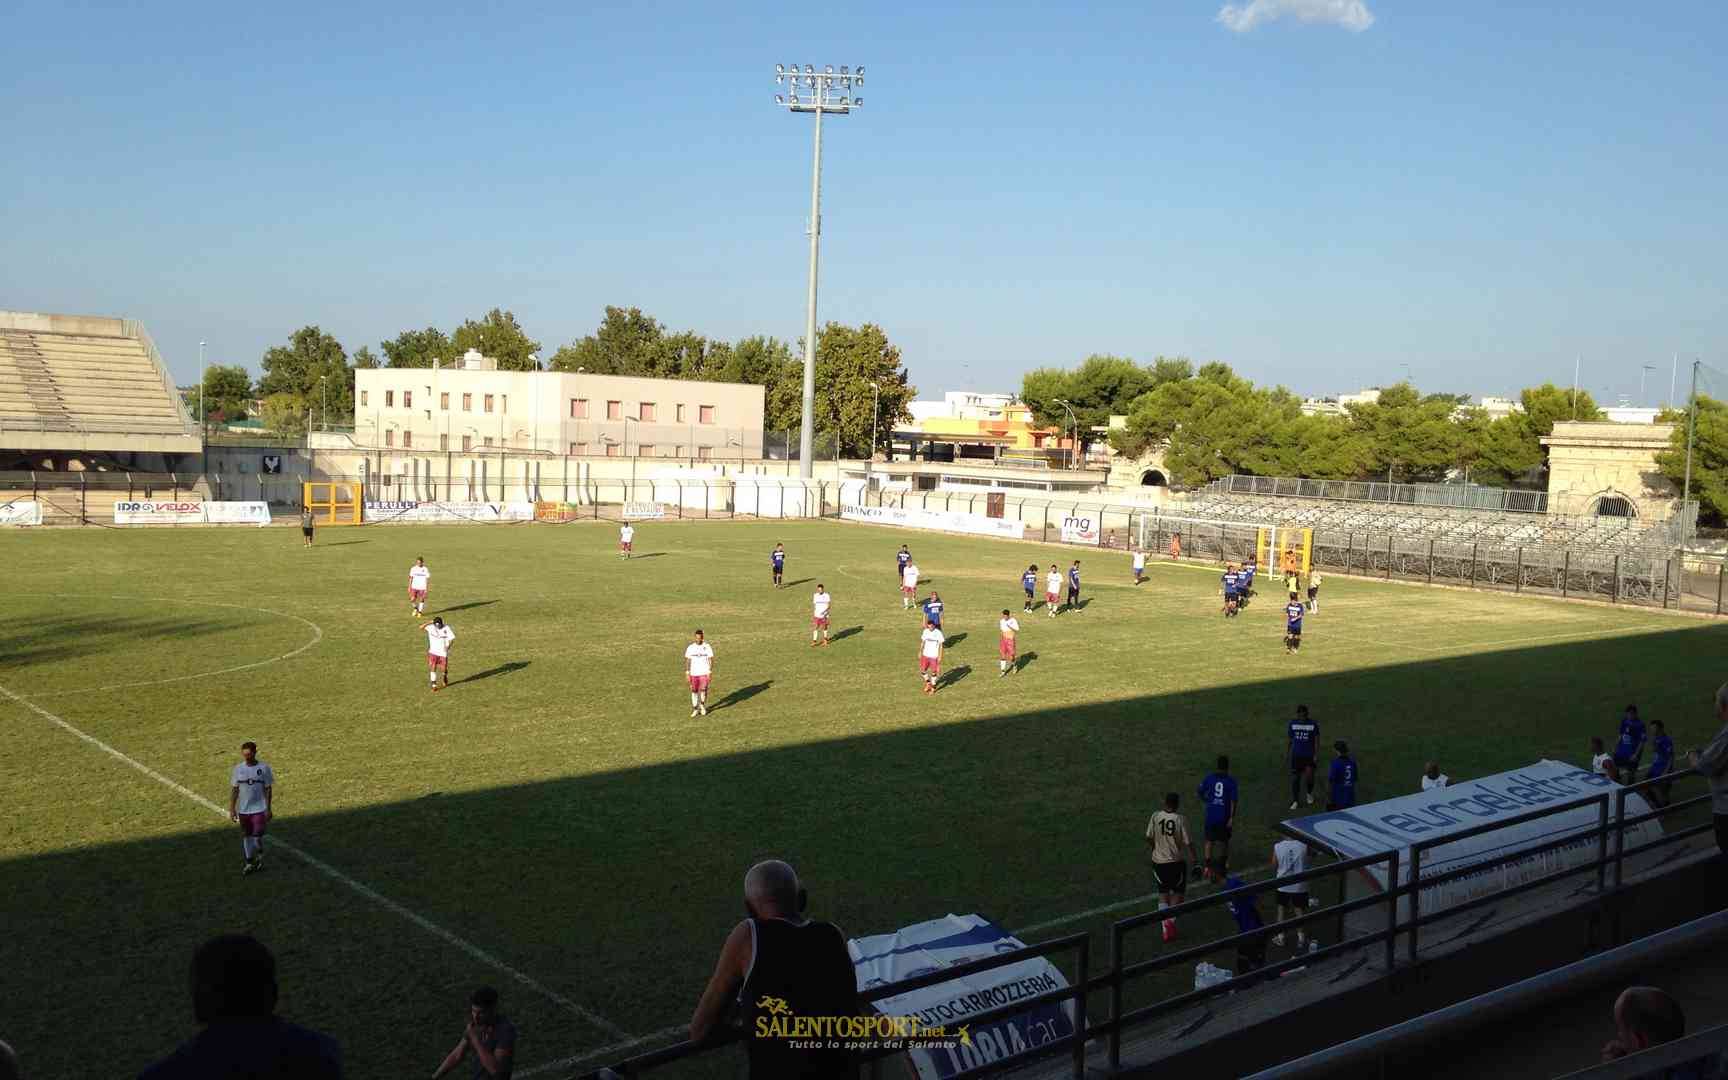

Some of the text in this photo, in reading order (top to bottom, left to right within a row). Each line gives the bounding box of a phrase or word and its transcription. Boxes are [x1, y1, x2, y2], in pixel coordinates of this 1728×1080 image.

[1064, 515, 1091, 532] mg
[1213, 781, 1224, 797] 9
[1380, 770, 1612, 833] euroelettra
[1159, 818, 1176, 836] 19
